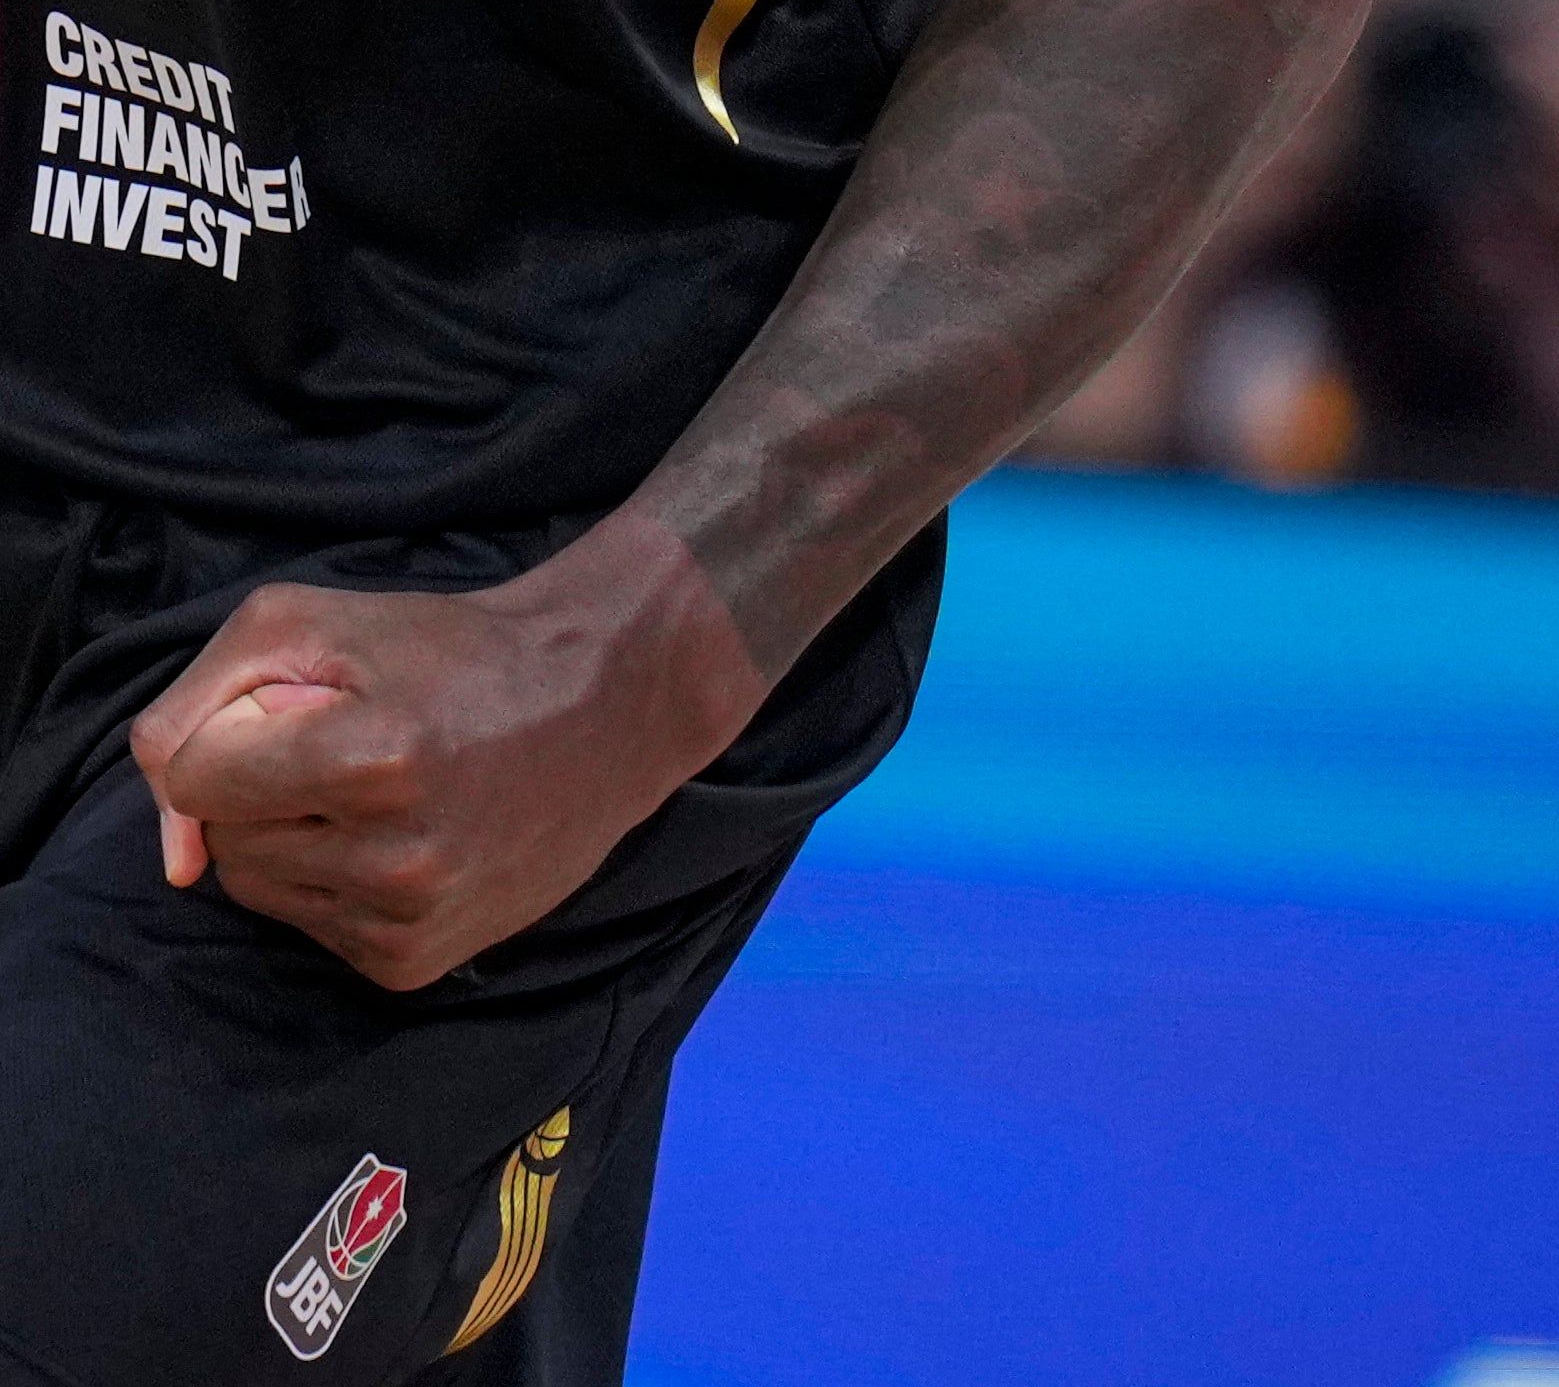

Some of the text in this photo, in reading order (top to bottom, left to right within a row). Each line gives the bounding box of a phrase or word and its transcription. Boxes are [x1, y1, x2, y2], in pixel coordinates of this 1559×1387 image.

[45, 11, 235, 134] CREDIT
[40, 83, 311, 233] FINANCER
[30, 164, 252, 282] INVEST
[275, 1255, 344, 1337] JBF
